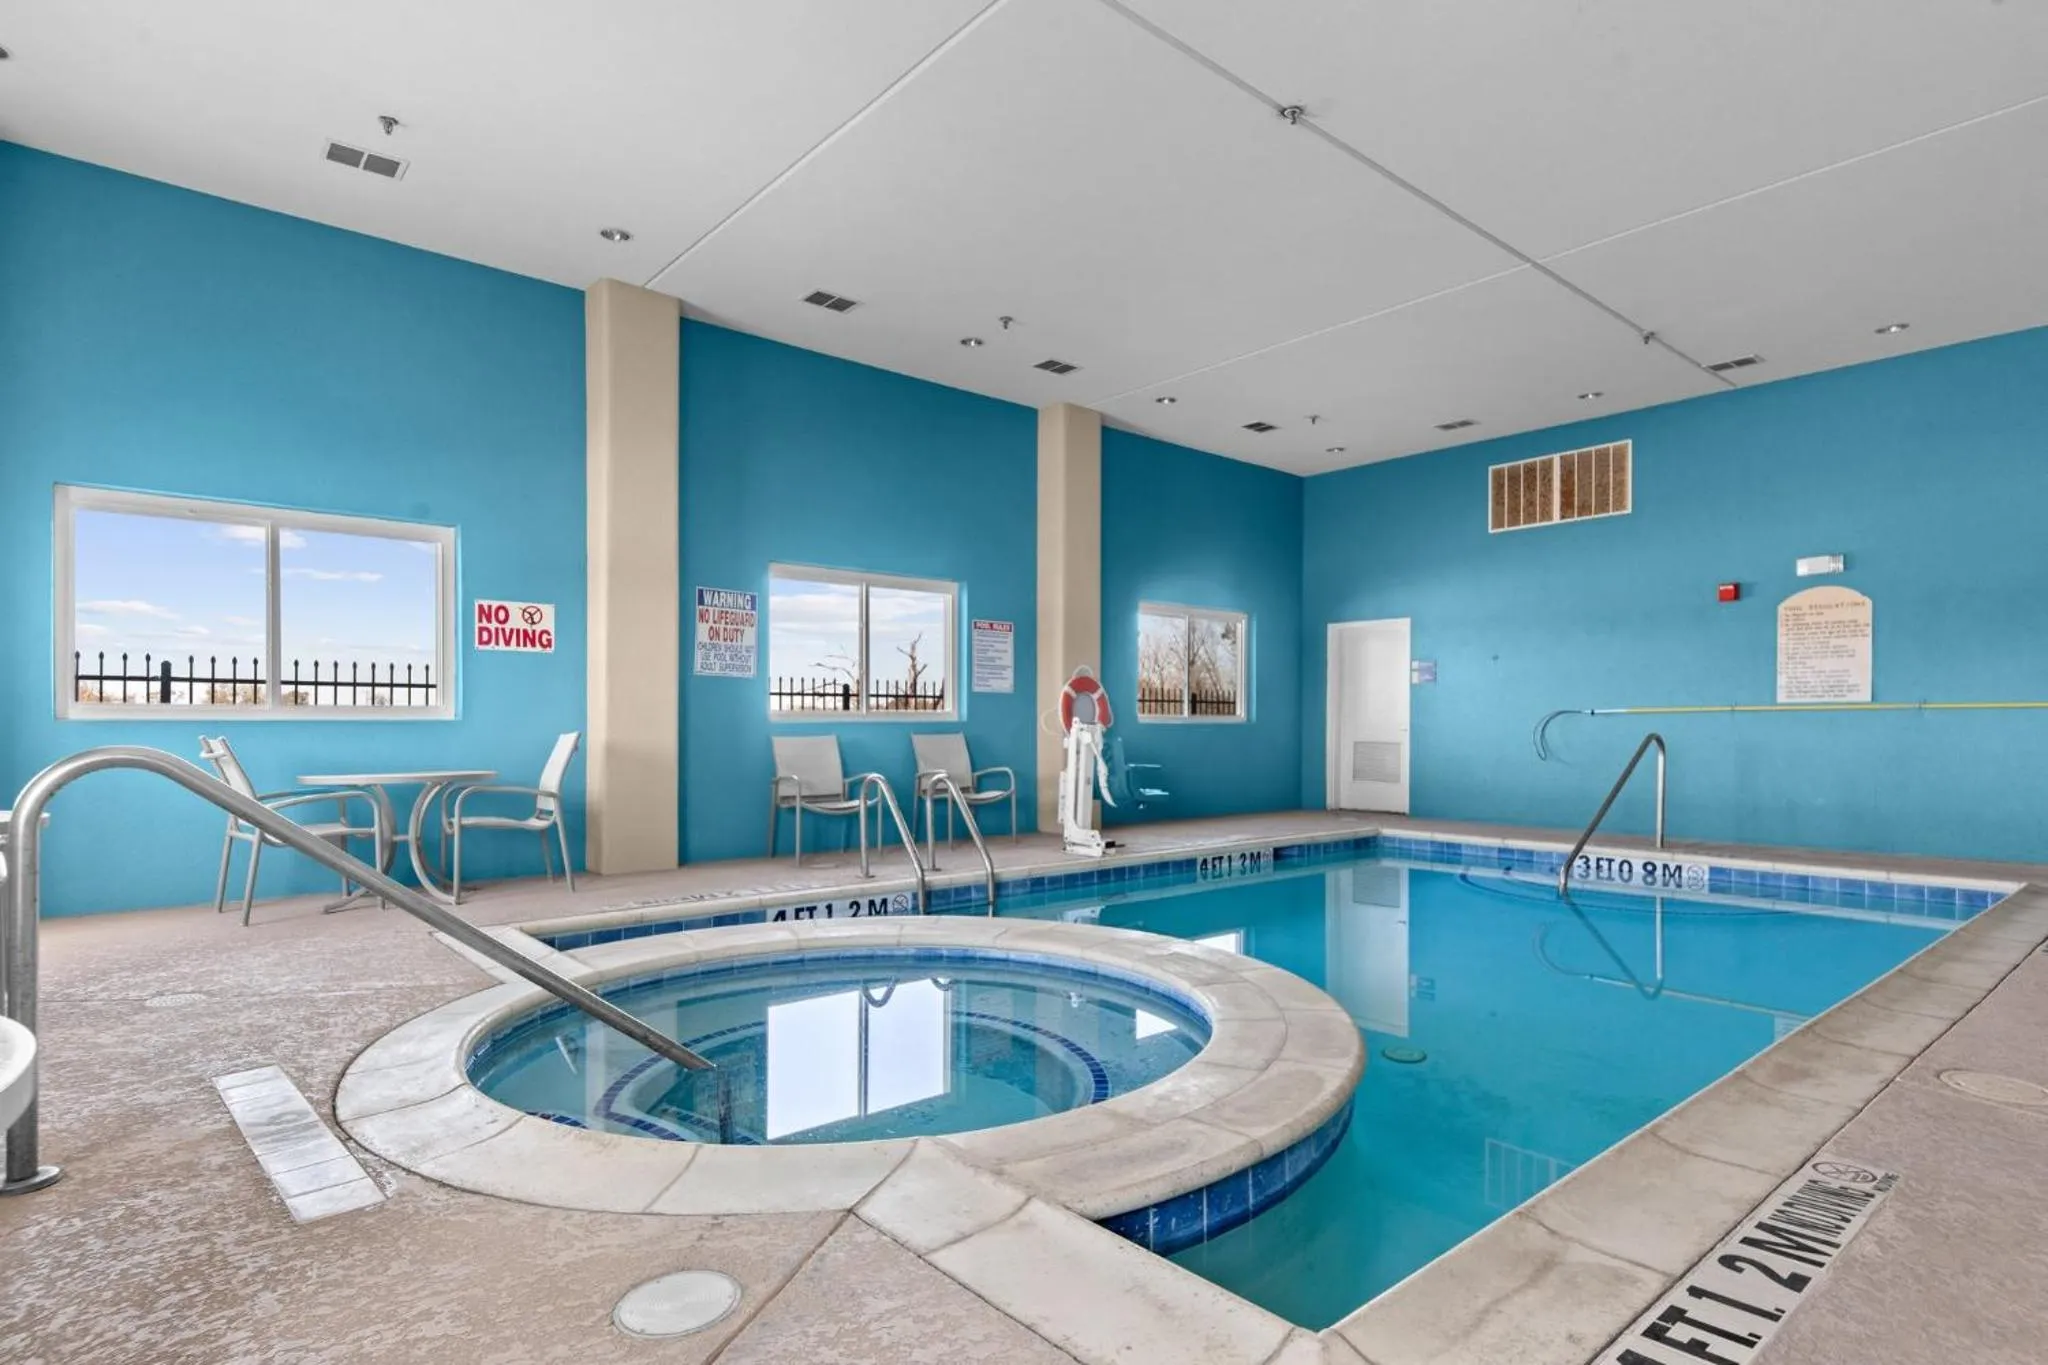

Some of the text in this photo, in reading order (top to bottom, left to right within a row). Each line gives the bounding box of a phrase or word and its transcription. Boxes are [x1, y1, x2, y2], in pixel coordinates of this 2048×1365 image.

[703, 589, 752, 609] WARNING
[478, 604, 510, 625] NO
[698, 608, 754, 628] NO LIFEGUARD
[478, 626, 552, 649] DIVING
[708, 625, 744, 643] ON DUTY
